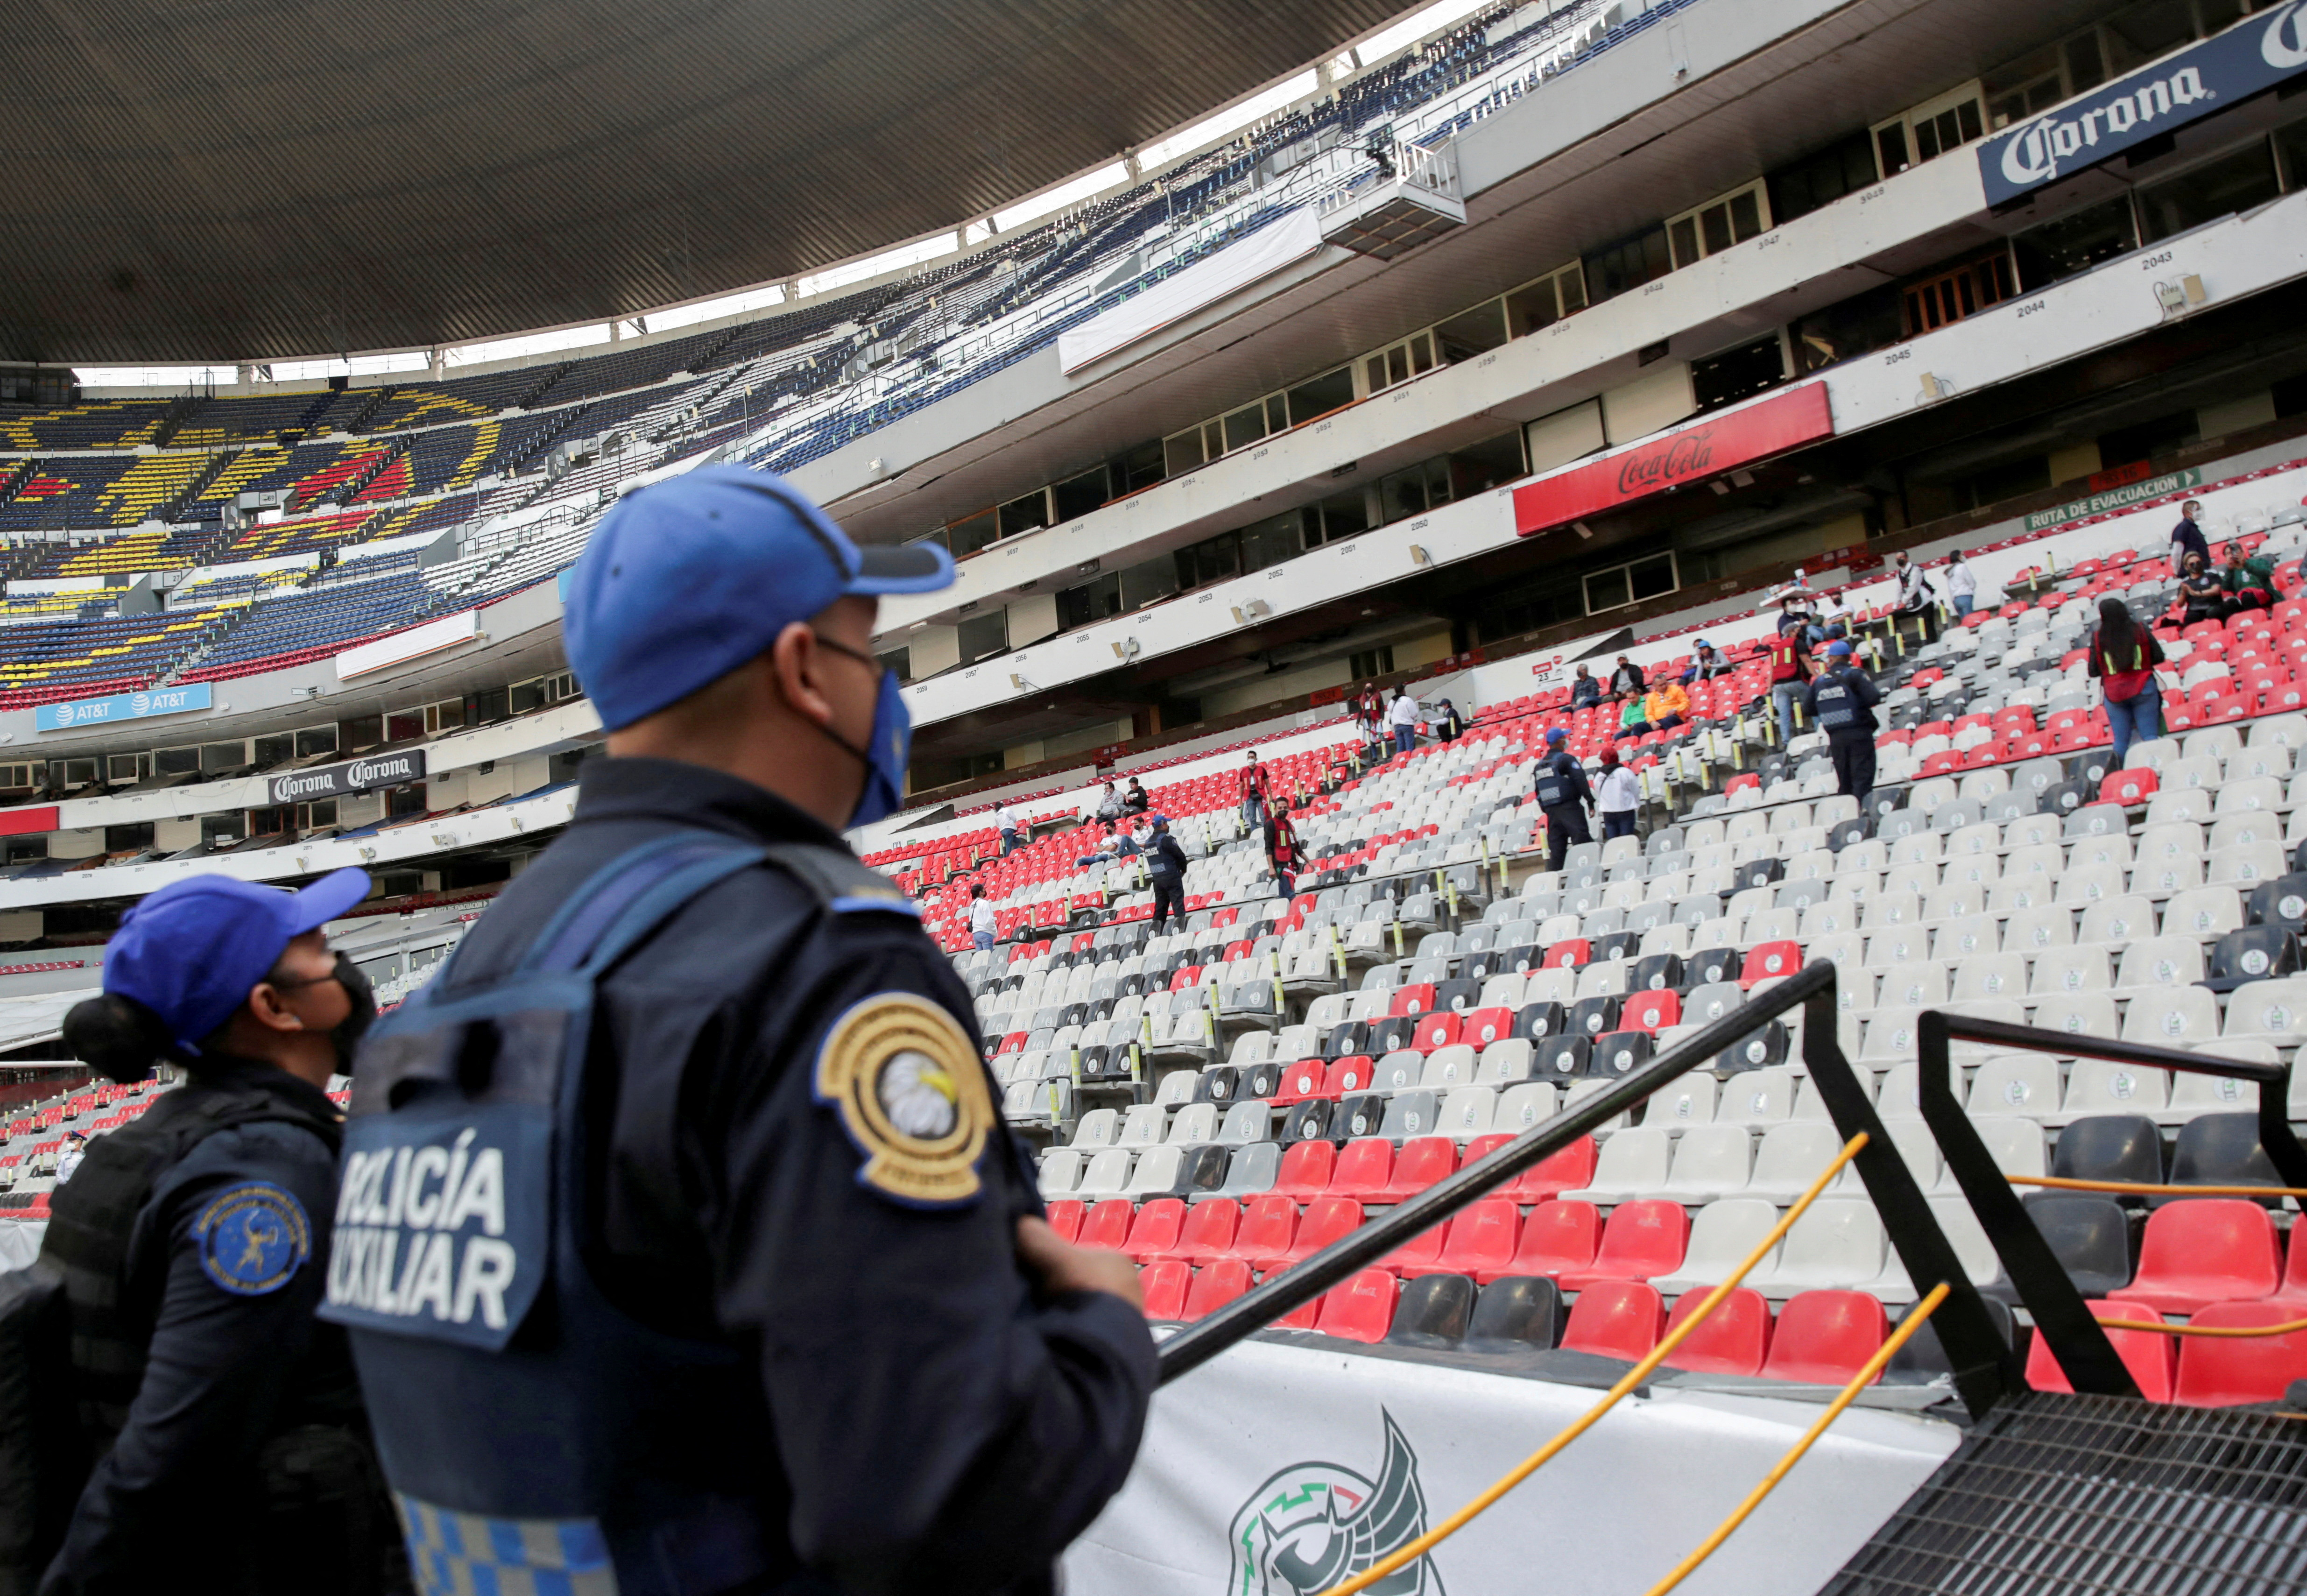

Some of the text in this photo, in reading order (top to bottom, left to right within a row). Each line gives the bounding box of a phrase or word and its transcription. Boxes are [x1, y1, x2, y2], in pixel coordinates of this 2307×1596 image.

[2001, 67, 2208, 184] Corona
[2142, 252, 2173, 270] 2043
[2017, 300, 2045, 318] 2044
[1885, 349, 1911, 365] 2045
[1393, 391, 1409, 403] 3051
[1316, 422, 1331, 433] 3052
[1254, 449, 1268, 460] 3053
[1618, 429, 1714, 494] Coca-Cola
[1181, 478, 1195, 487] 3054
[1126, 501, 1139, 509] 3055
[2032, 475, 2179, 528] RUTA DE EVACUACIÓN
[1071, 524, 1084, 533] 3056
[1411, 519, 1428, 530] 2050
[1341, 544, 1355, 555] 2051
[1269, 569, 1283, 579] 2052
[1199, 593, 1212, 603] 2053
[1138, 614, 1151, 623] 2054
[1077, 634, 1089, 643] 2055
[1016, 654, 1027, 663] 2056
[966, 670, 976, 678] 2057
[1538, 673, 1549, 682] 23
[77, 692, 187, 720] AT&T AT&T
[274, 758, 410, 802] Corona Corona
[326, 1228, 516, 1329] UXILIAR
